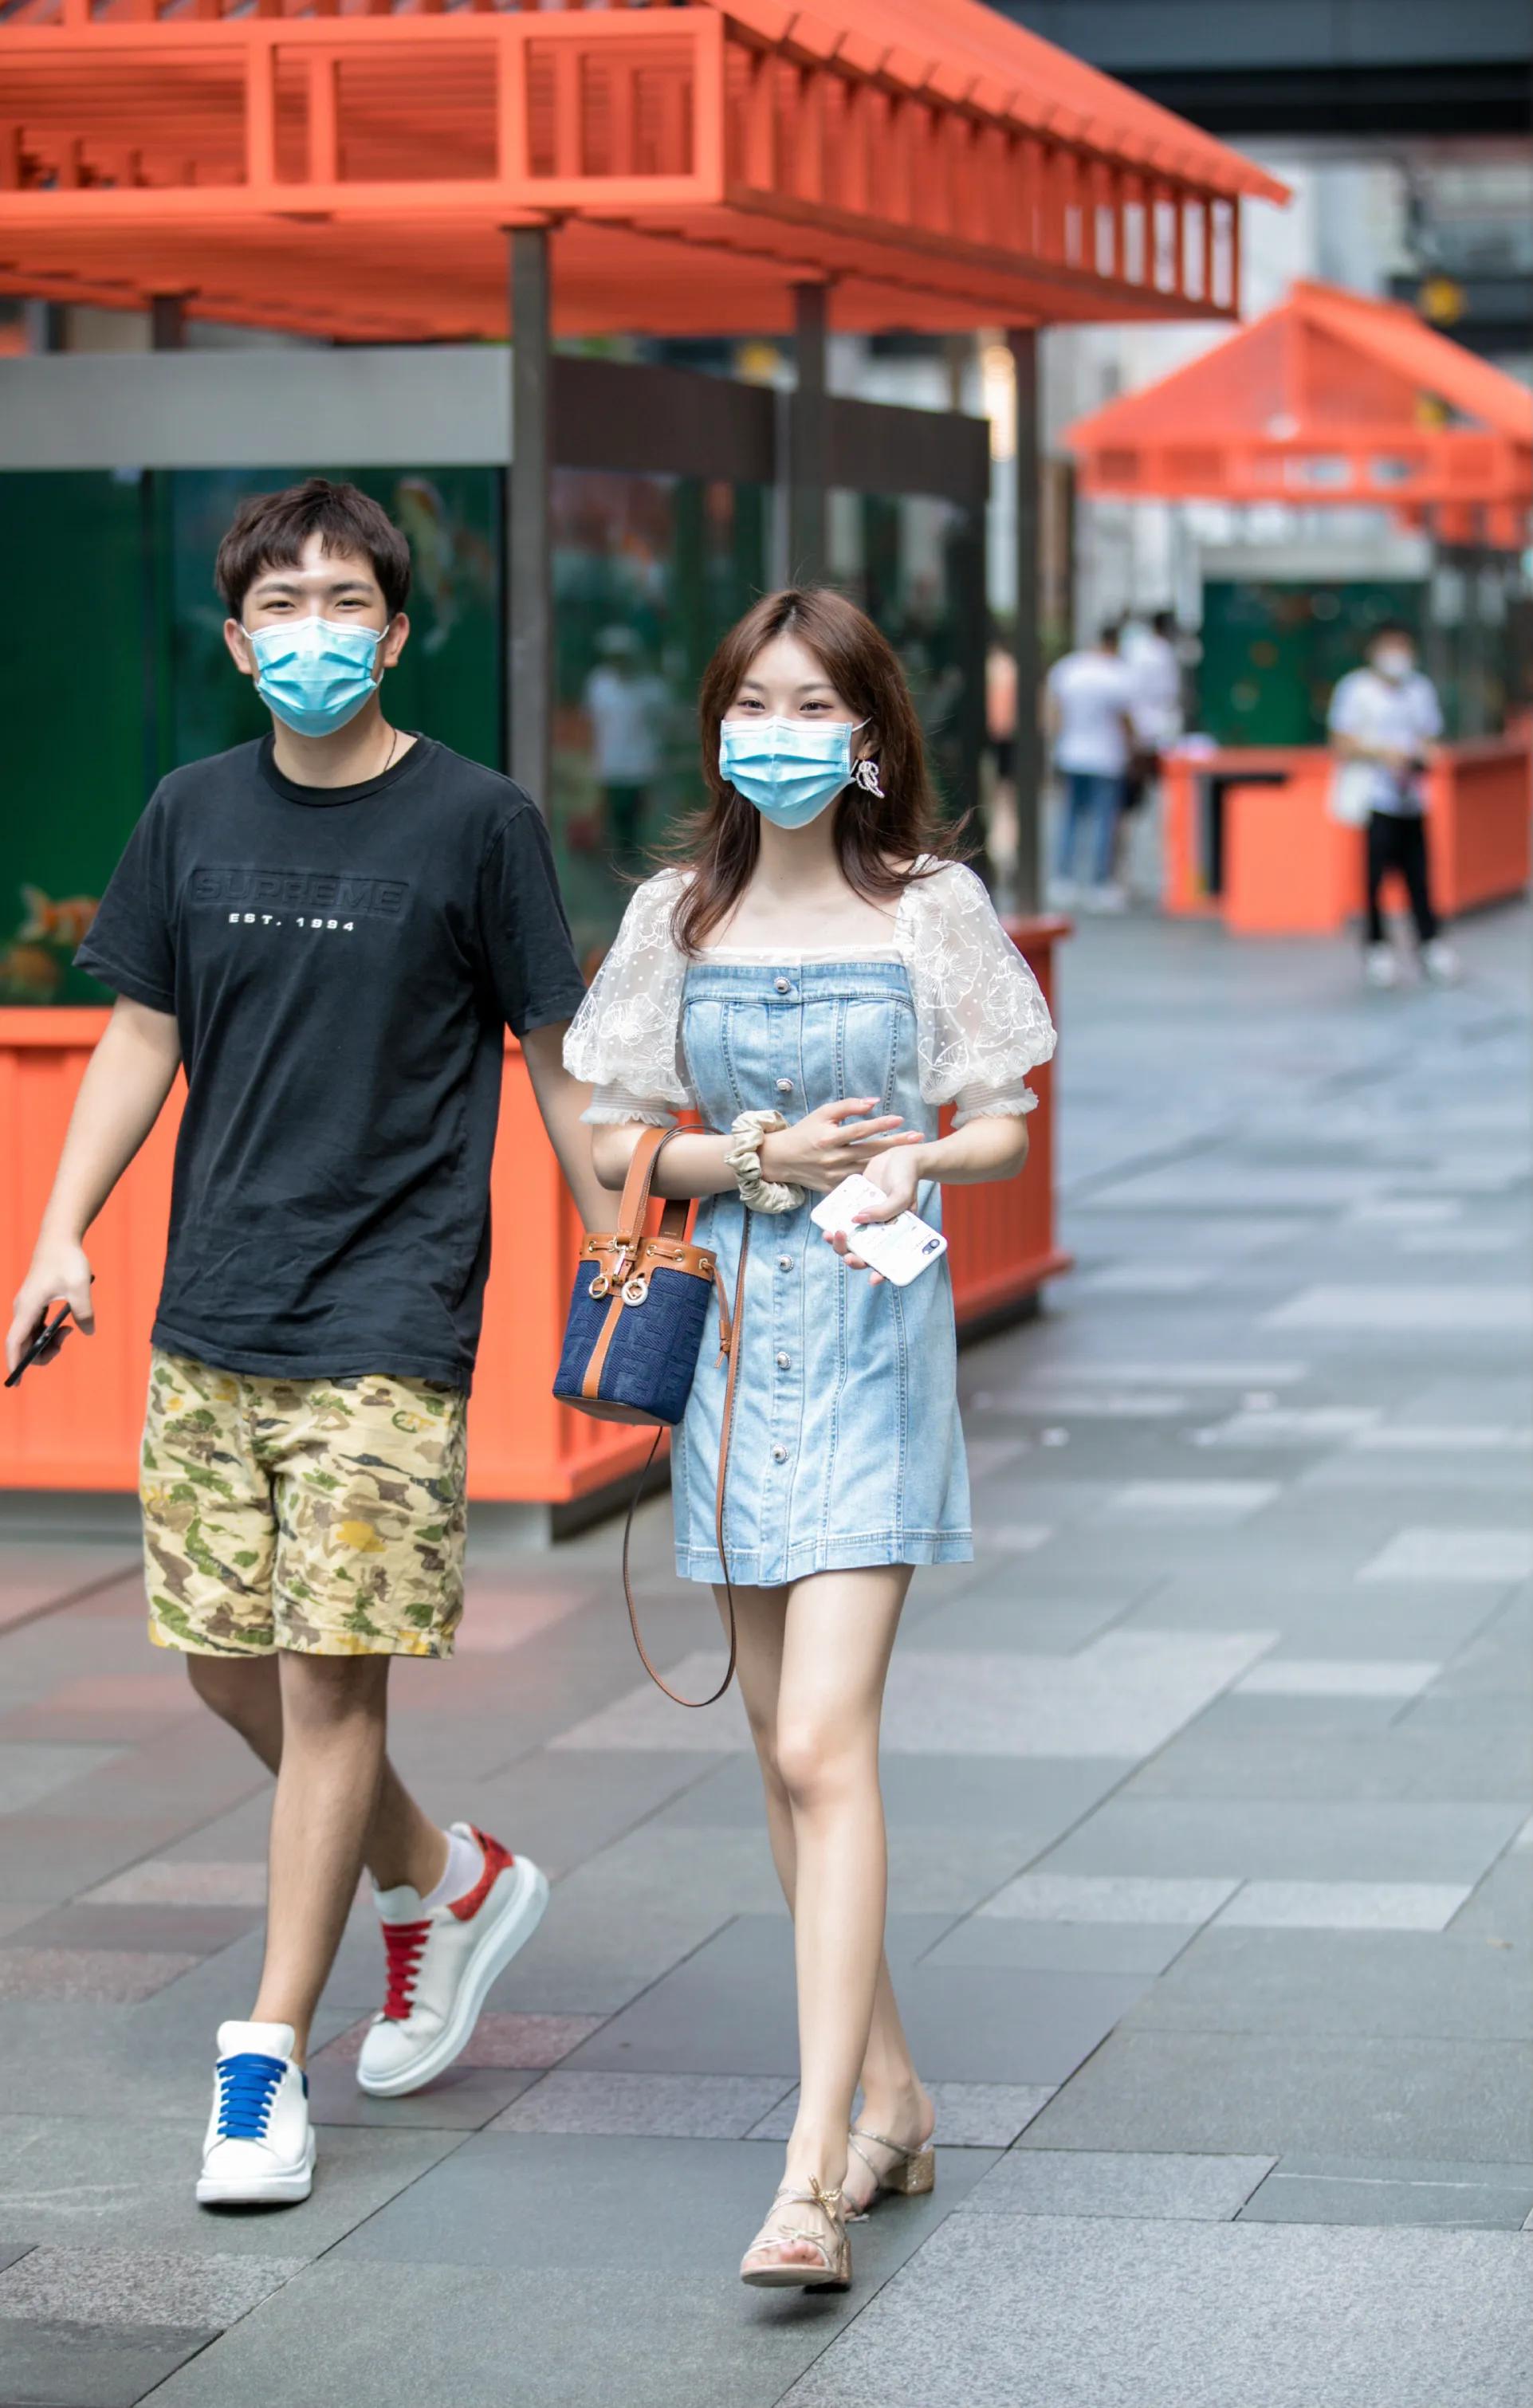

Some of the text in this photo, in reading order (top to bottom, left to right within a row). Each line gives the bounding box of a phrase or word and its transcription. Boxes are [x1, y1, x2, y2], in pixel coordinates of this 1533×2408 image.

[194, 877, 402, 913] SUPREME
[228, 913, 354, 932] EST. 1994
